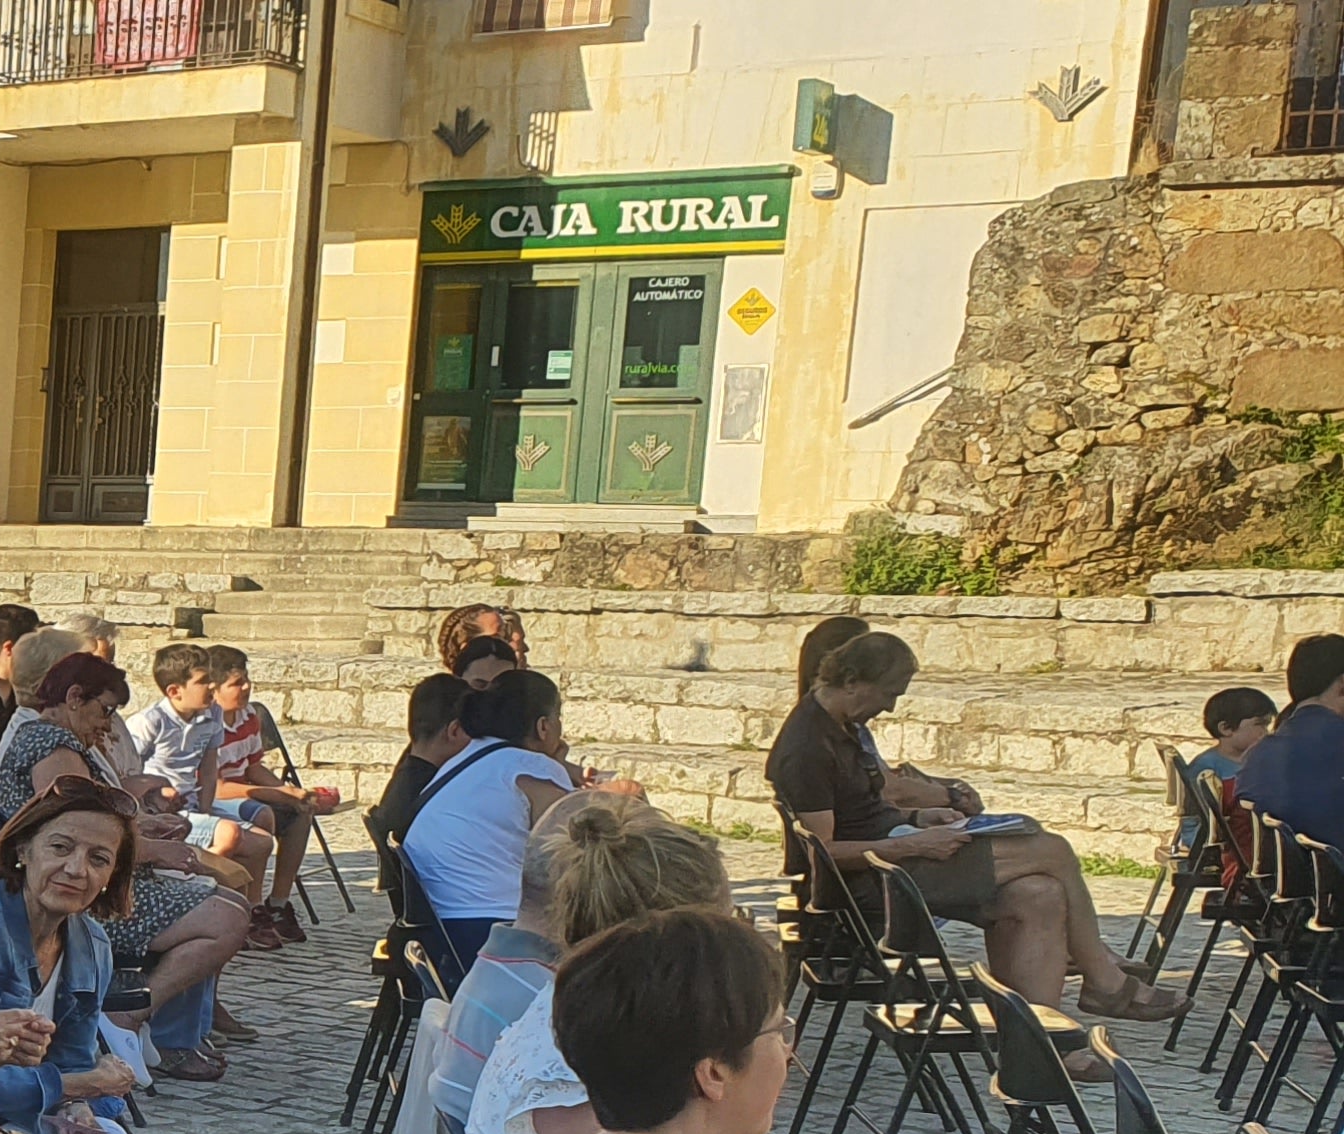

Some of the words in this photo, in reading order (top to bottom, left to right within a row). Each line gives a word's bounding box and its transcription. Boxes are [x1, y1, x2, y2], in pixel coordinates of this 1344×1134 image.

[490, 202, 597, 239] CAJA
[616, 194, 780, 234] RURAL
[648, 276, 690, 288] CAJERO
[633, 288, 703, 301] AUTOMÁTICO
